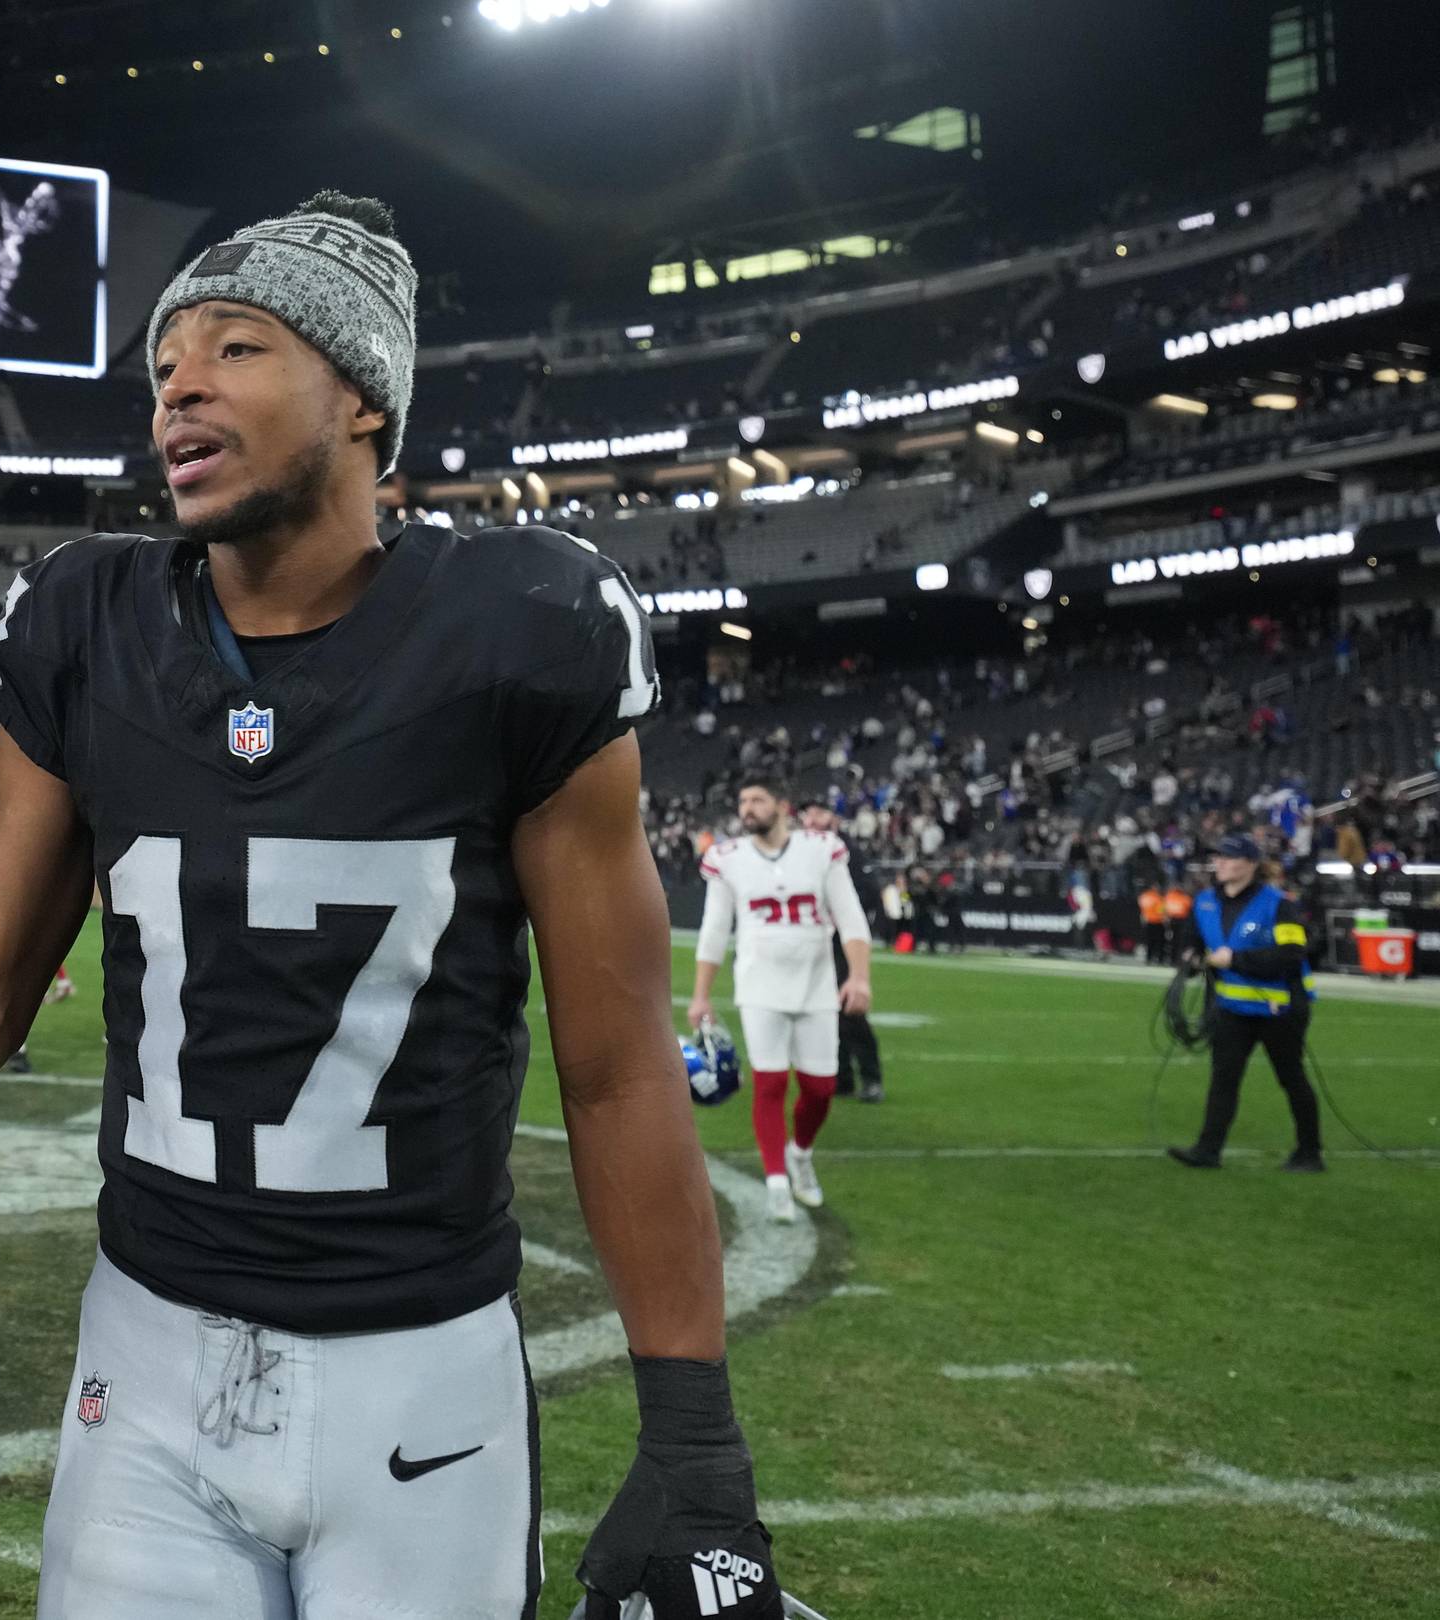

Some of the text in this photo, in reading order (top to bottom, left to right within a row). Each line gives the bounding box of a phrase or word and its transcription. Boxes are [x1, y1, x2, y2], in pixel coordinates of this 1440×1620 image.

[236, 730, 266, 752] NFL
[108, 835, 457, 1192] 17
[80, 1397, 101, 1421] NFL
